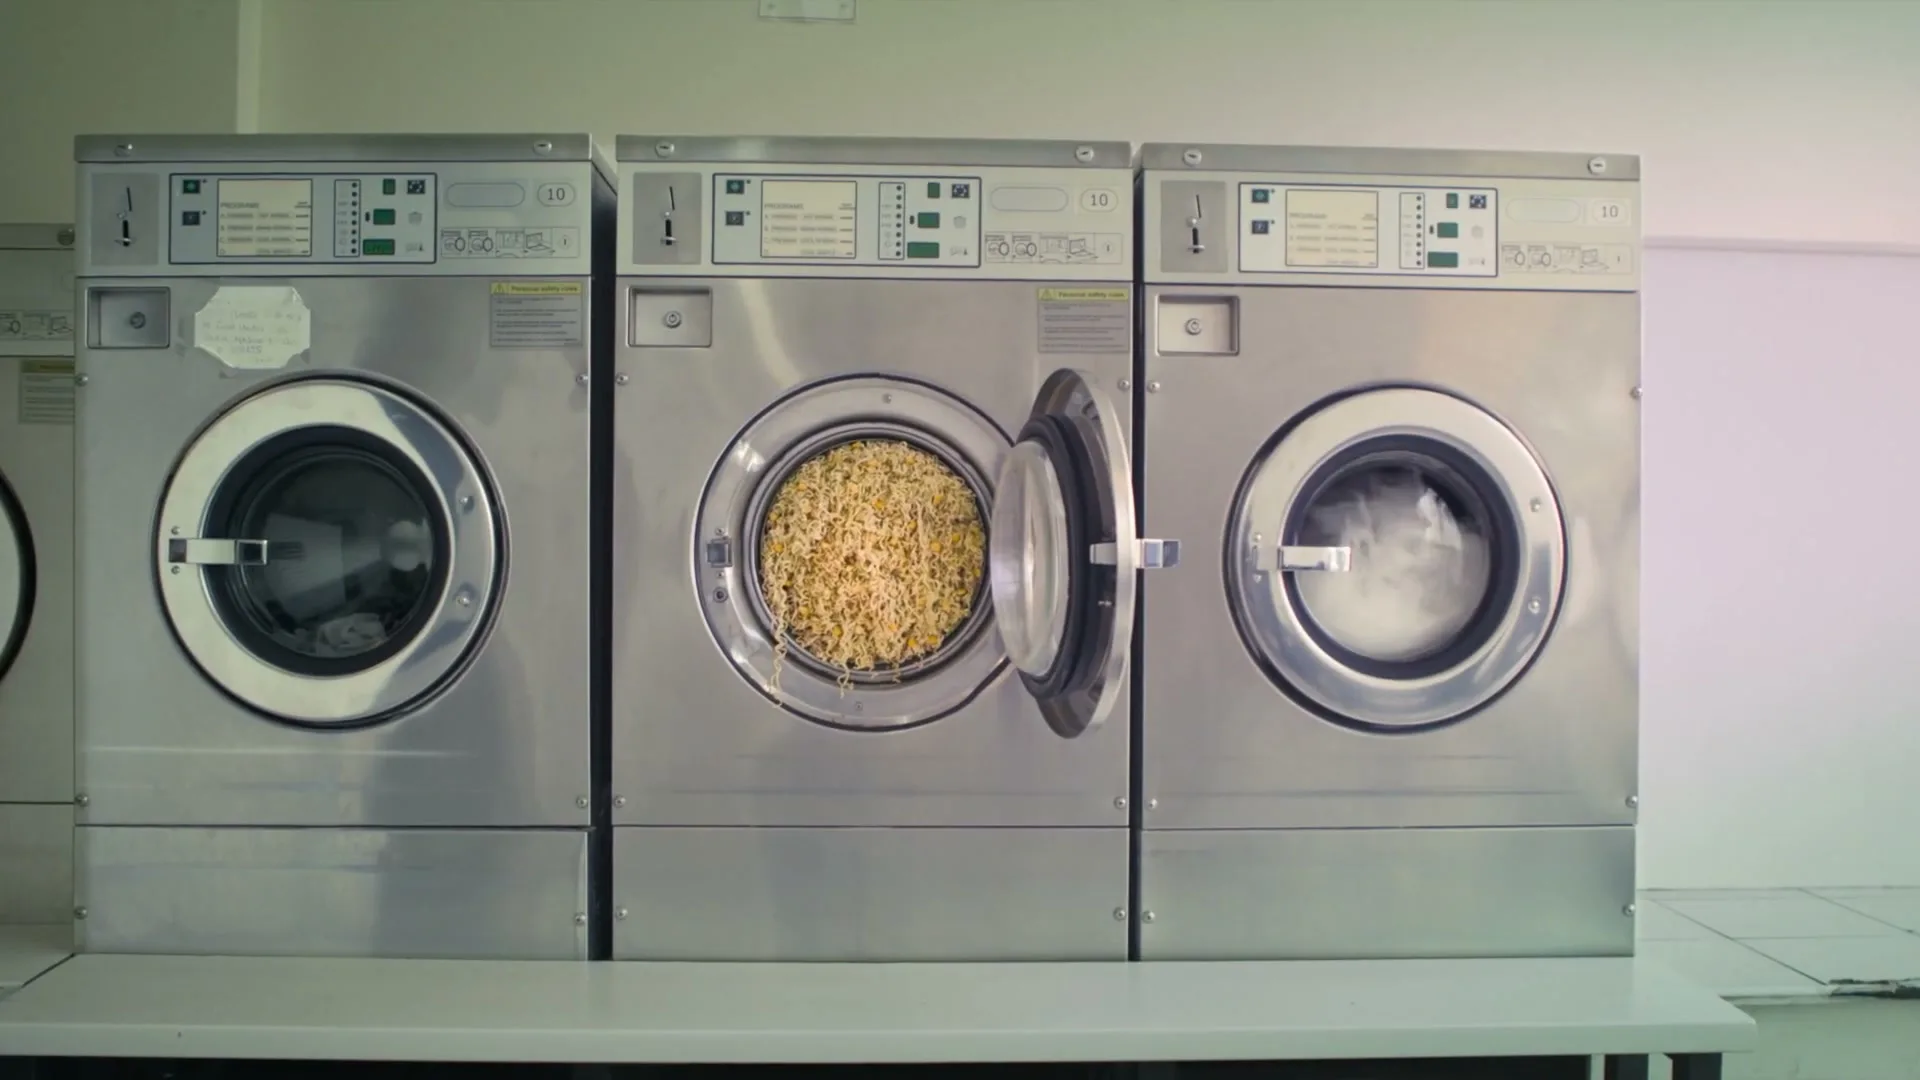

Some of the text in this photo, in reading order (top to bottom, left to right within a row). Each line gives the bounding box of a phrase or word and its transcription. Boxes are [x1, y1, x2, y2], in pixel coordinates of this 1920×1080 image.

[547, 187, 566, 201] 10
[1090, 193, 1109, 207] 10
[1602, 205, 1619, 218] 10
